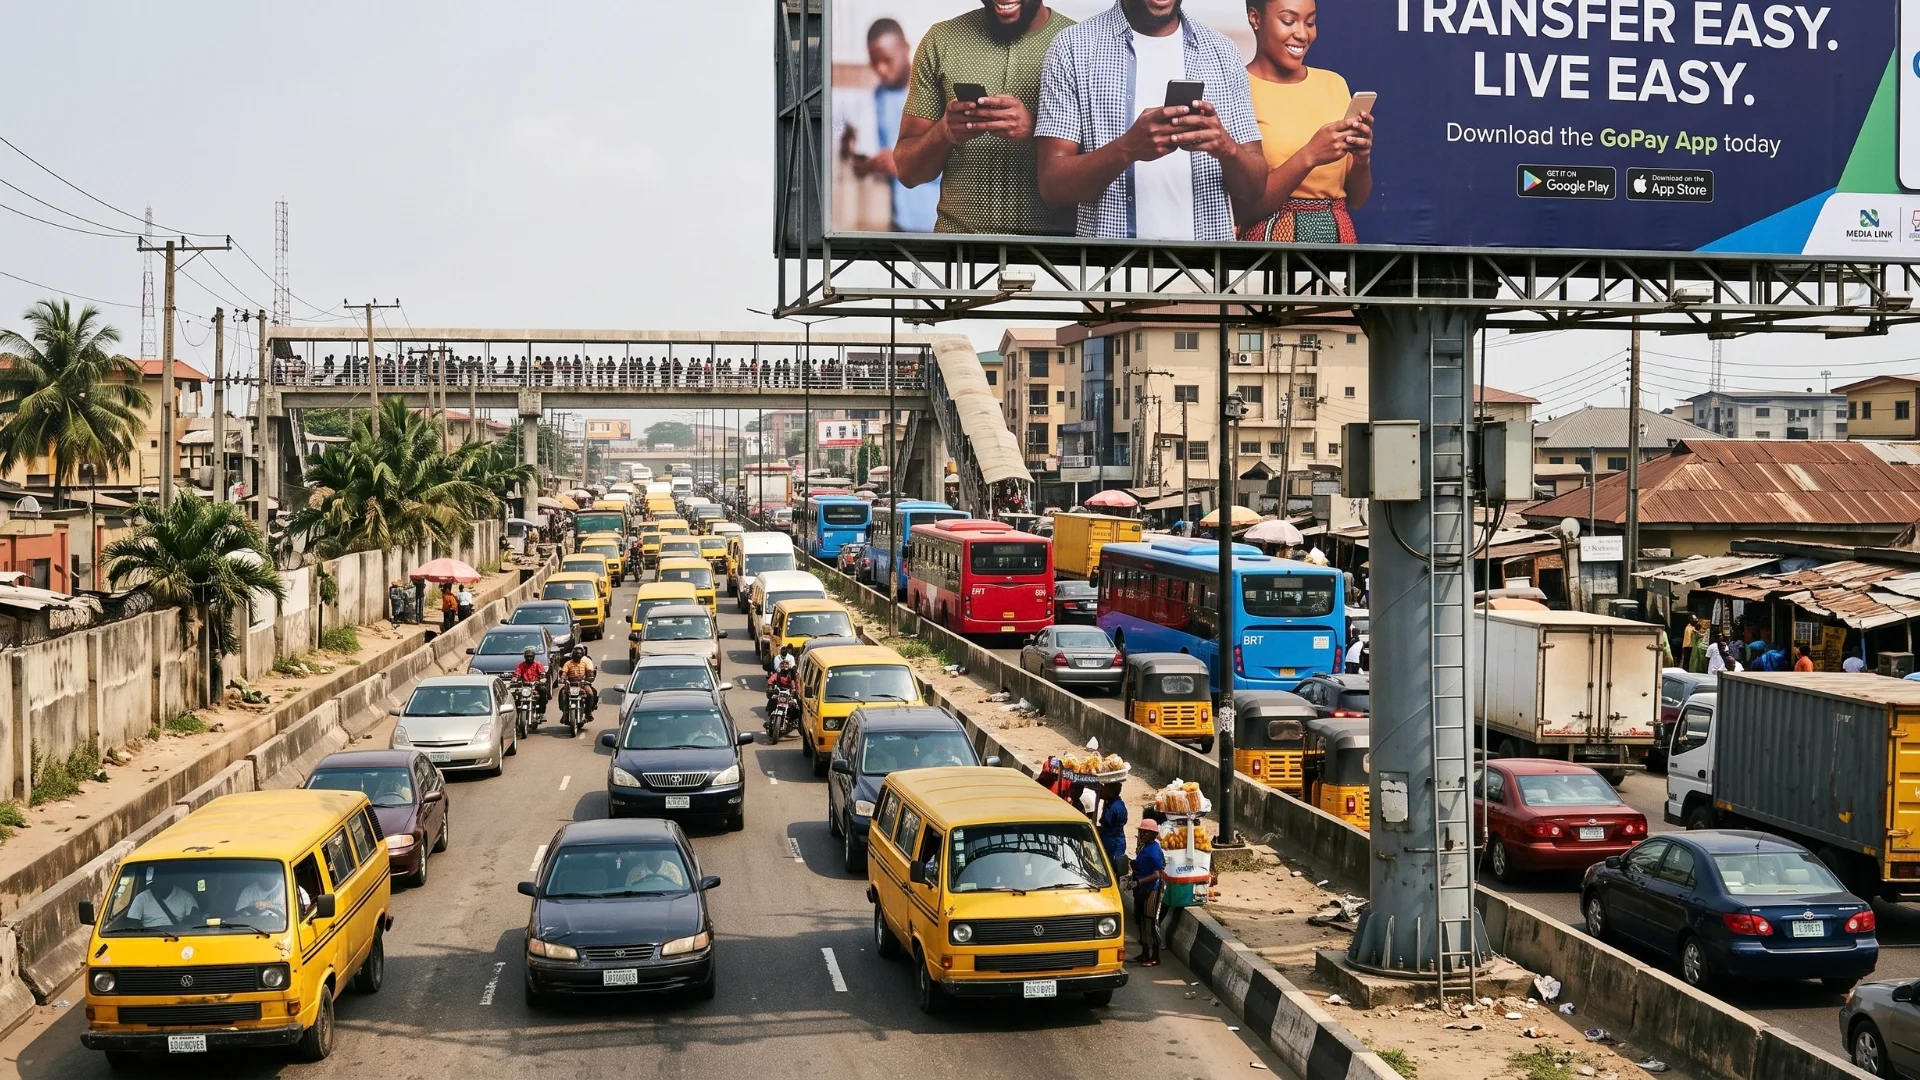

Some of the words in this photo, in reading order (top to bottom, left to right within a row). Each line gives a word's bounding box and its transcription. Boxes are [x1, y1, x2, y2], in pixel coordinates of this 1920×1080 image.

[1694, 1, 1838, 50] EASY.
[1475, 51, 1590, 99] LIVE
[1608, 56, 1754, 105] EASY.
[1447, 122, 1553, 145] Download
[1560, 126, 1593, 146] the
[1600, 127, 1669, 154] GoPay
[1674, 130, 1718, 155] App
[1724, 134, 1781, 158] today
[1546, 179, 1586, 194] Google
[1587, 180, 1610, 195] Play
[1651, 183, 1675, 196] App
[1676, 184, 1707, 196] Store
[1243, 635, 1264, 645] BRT
